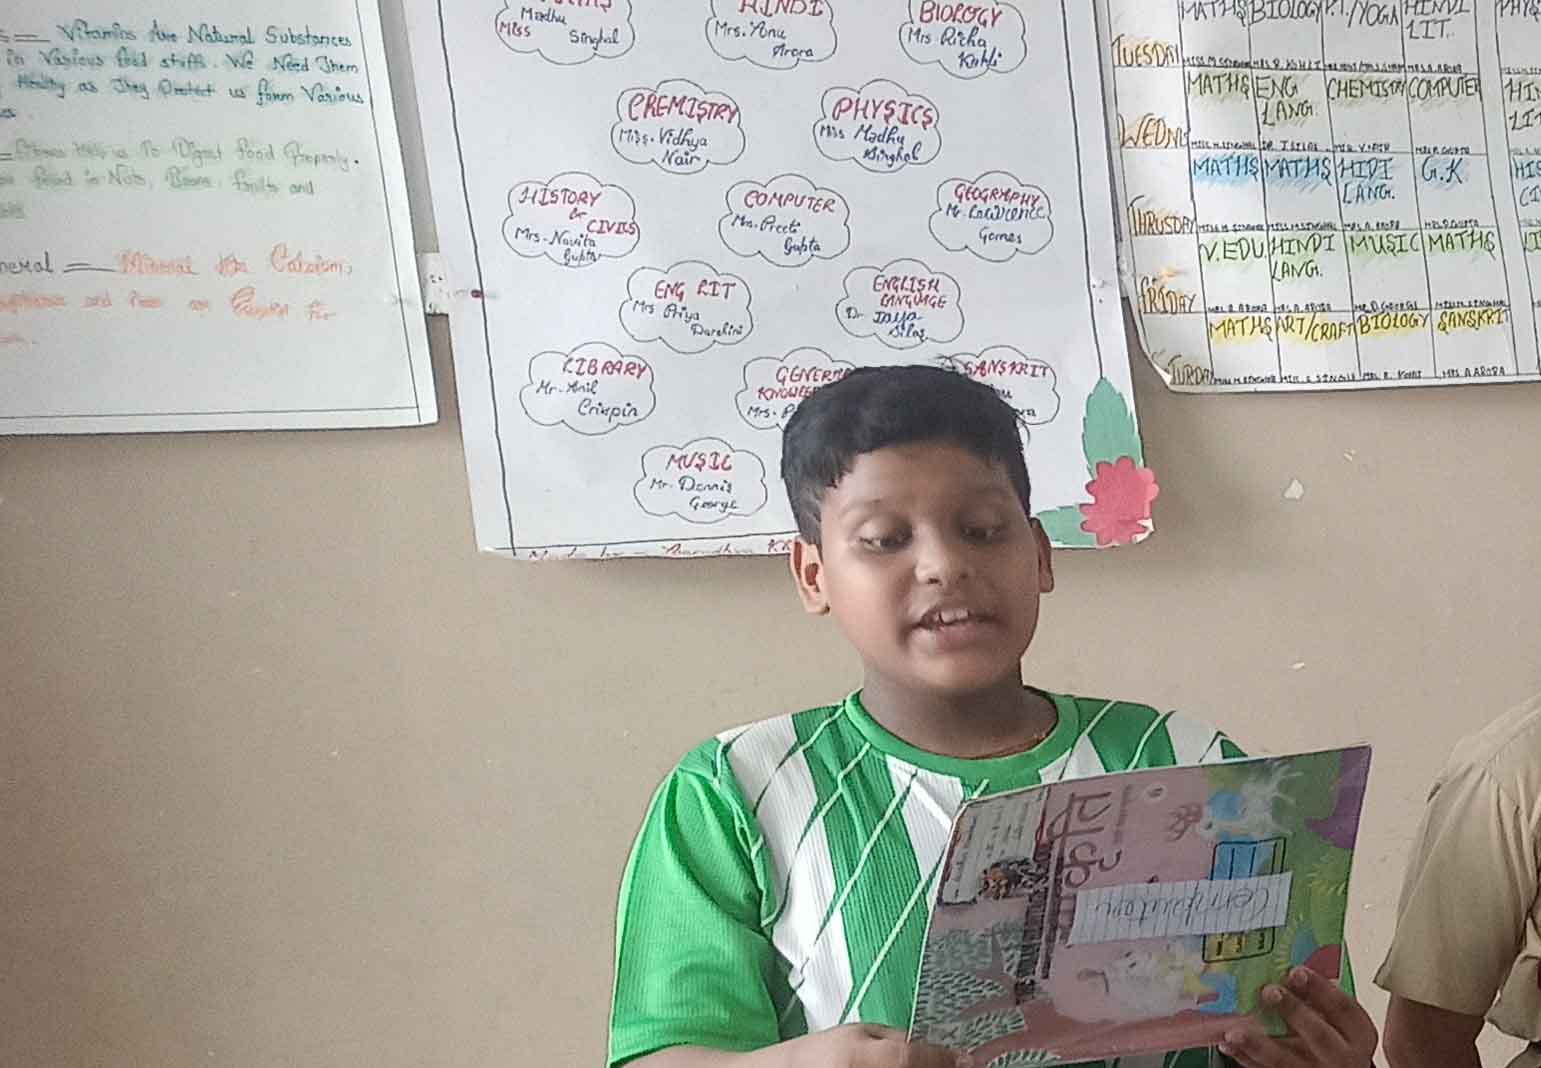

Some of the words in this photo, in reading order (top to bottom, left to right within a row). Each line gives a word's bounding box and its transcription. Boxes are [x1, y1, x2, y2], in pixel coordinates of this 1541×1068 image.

[919, 0, 1003, 27] BIOLOGY
[1182, 0, 1247, 27] MATHS
[1250, 0, 1320, 25] BIOLOGY
[265, 25, 352, 47] Substances
[301, 82, 364, 105] Various
[1188, 72, 1250, 103] MATHS
[1256, 76, 1297, 97] ENG
[628, 94, 739, 123] CHEMISTRY
[831, 96, 935, 129] PHYSICS
[659, 128, 708, 151] Vidhya
[853, 124, 906, 146] Madhu
[661, 148, 702, 167] Nair
[1193, 157, 1260, 182] MATHS
[1265, 156, 1333, 187] MATHS
[519, 186, 602, 207] HISTORY
[744, 190, 836, 214] COMPUTER
[954, 182, 1041, 207] GEOGRAPHY
[784, 235, 821, 256] Gupta
[1272, 233, 1335, 256] HINDI
[1351, 233, 1420, 258] MUSIC
[1429, 233, 1496, 260] MATHS
[654, 280, 685, 301] ENG
[873, 274, 940, 293] ENGLISH
[1208, 315, 1274, 342] MATHS
[1358, 313, 1429, 335] BIOLOGY
[562, 357, 648, 378] LIBRARY
[666, 452, 733, 471] MUSIC
